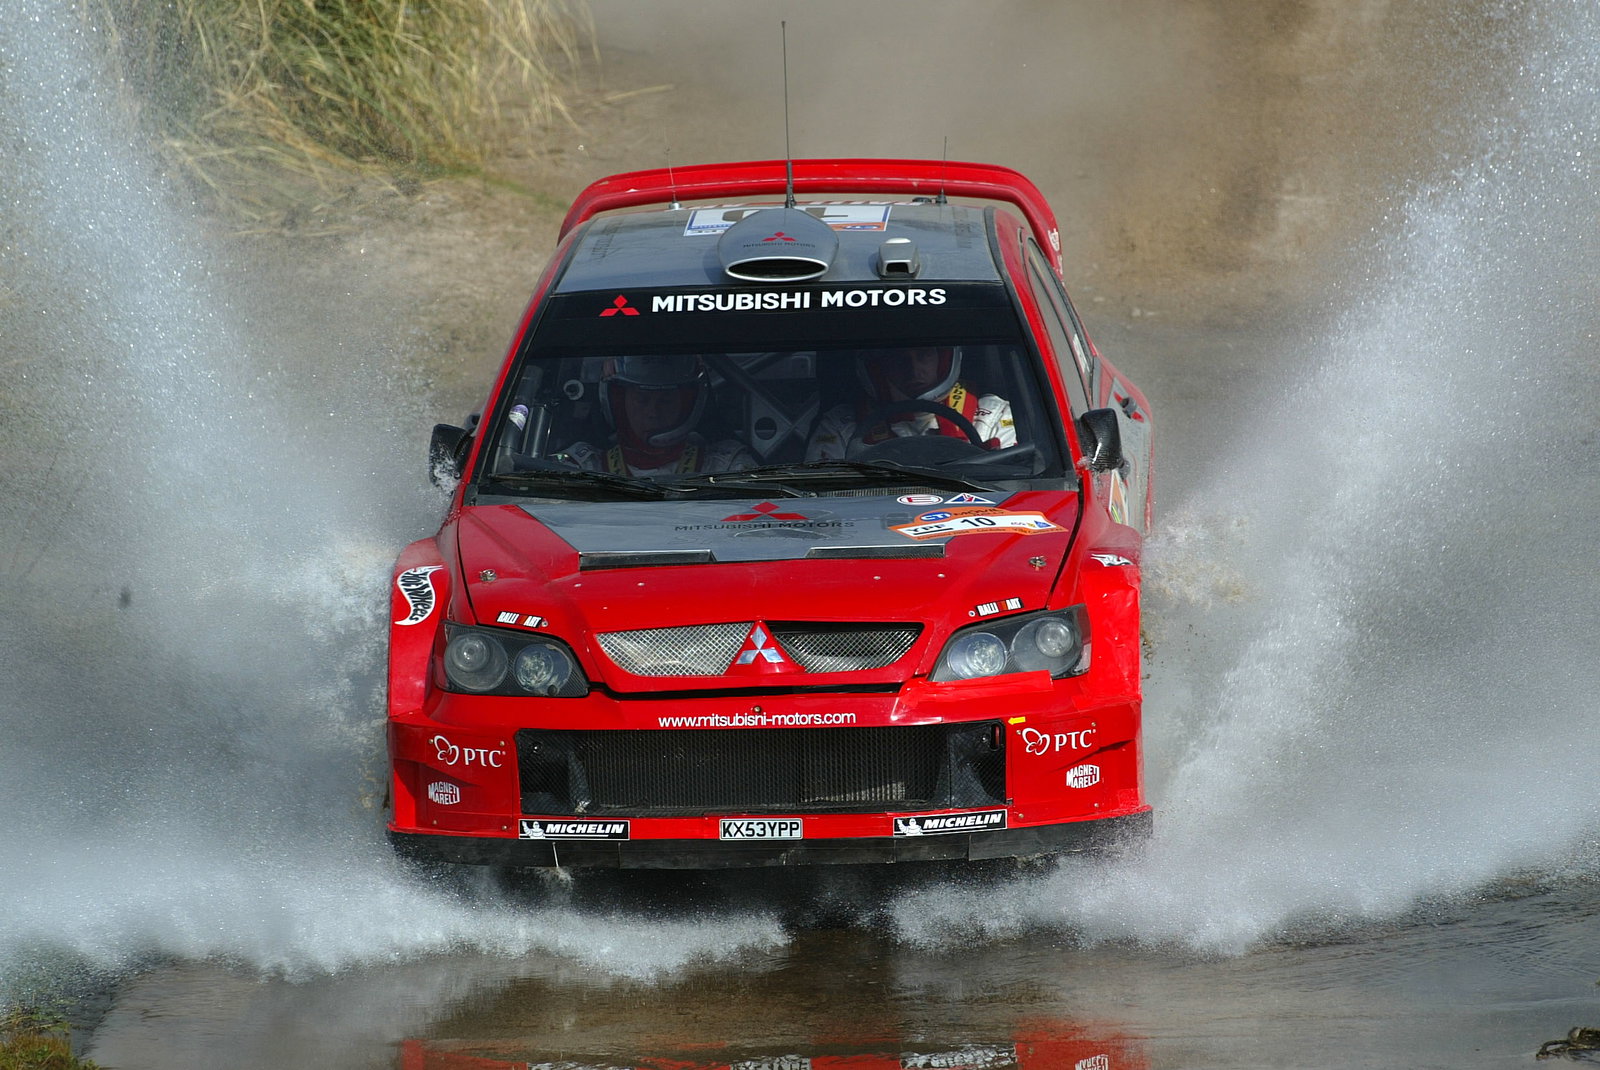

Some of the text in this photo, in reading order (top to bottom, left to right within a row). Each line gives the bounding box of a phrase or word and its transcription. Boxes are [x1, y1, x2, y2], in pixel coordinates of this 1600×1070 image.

[651, 288, 947, 313] MITSUBISHI MOTORS
[674, 521, 856, 532] MITSUBISHI MOTORS
[960, 516, 997, 528] 10
[1054, 728, 1093, 752] PTC
[463, 747, 503, 769] PTC
[545, 822, 626, 835] MICHELIN
[922, 813, 1003, 829] MICHELIN
[722, 821, 800, 838] KX53YPP
